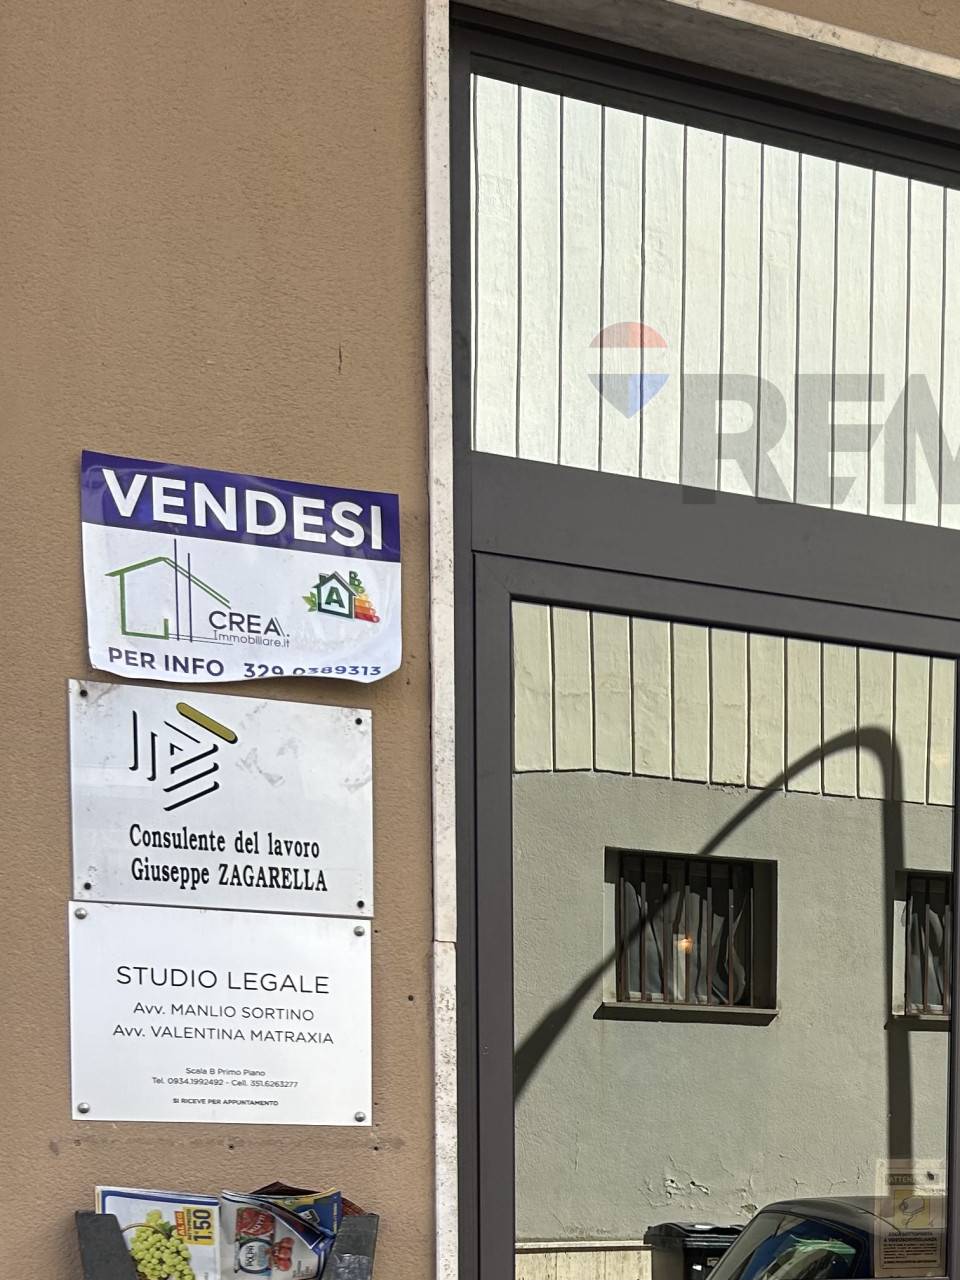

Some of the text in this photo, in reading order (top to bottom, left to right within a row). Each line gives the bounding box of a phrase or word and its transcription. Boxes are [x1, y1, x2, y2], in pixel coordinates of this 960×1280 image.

[102, 468, 383, 550] VENDESI
[213, 629, 290, 648] Immobiliare.it
[108, 646, 156, 669] PER
[164, 654, 225, 677] INFO
[243, 662, 284, 678] 329
[129, 823, 320, 859] Consulente del lavoro
[131, 856, 329, 892] Giuseppe ZAGARELLA
[116, 965, 330, 994] STUDIO LEGALE
[133, 1002, 315, 1021] Avv. MANLIO SORTINO
[112, 1024, 334, 1045] Avv. VALENTINA MATRAXIA
[152, 1076, 166, 1085] Tel.
[185, 1066, 207, 1076] Scala
[217, 1068, 242, 1077] Primo
[243, 1068, 266, 1078] Piano
[181, 1097, 206, 1105] RICEVE
[223, 1098, 279, 1107] APPUNTAMENTO
